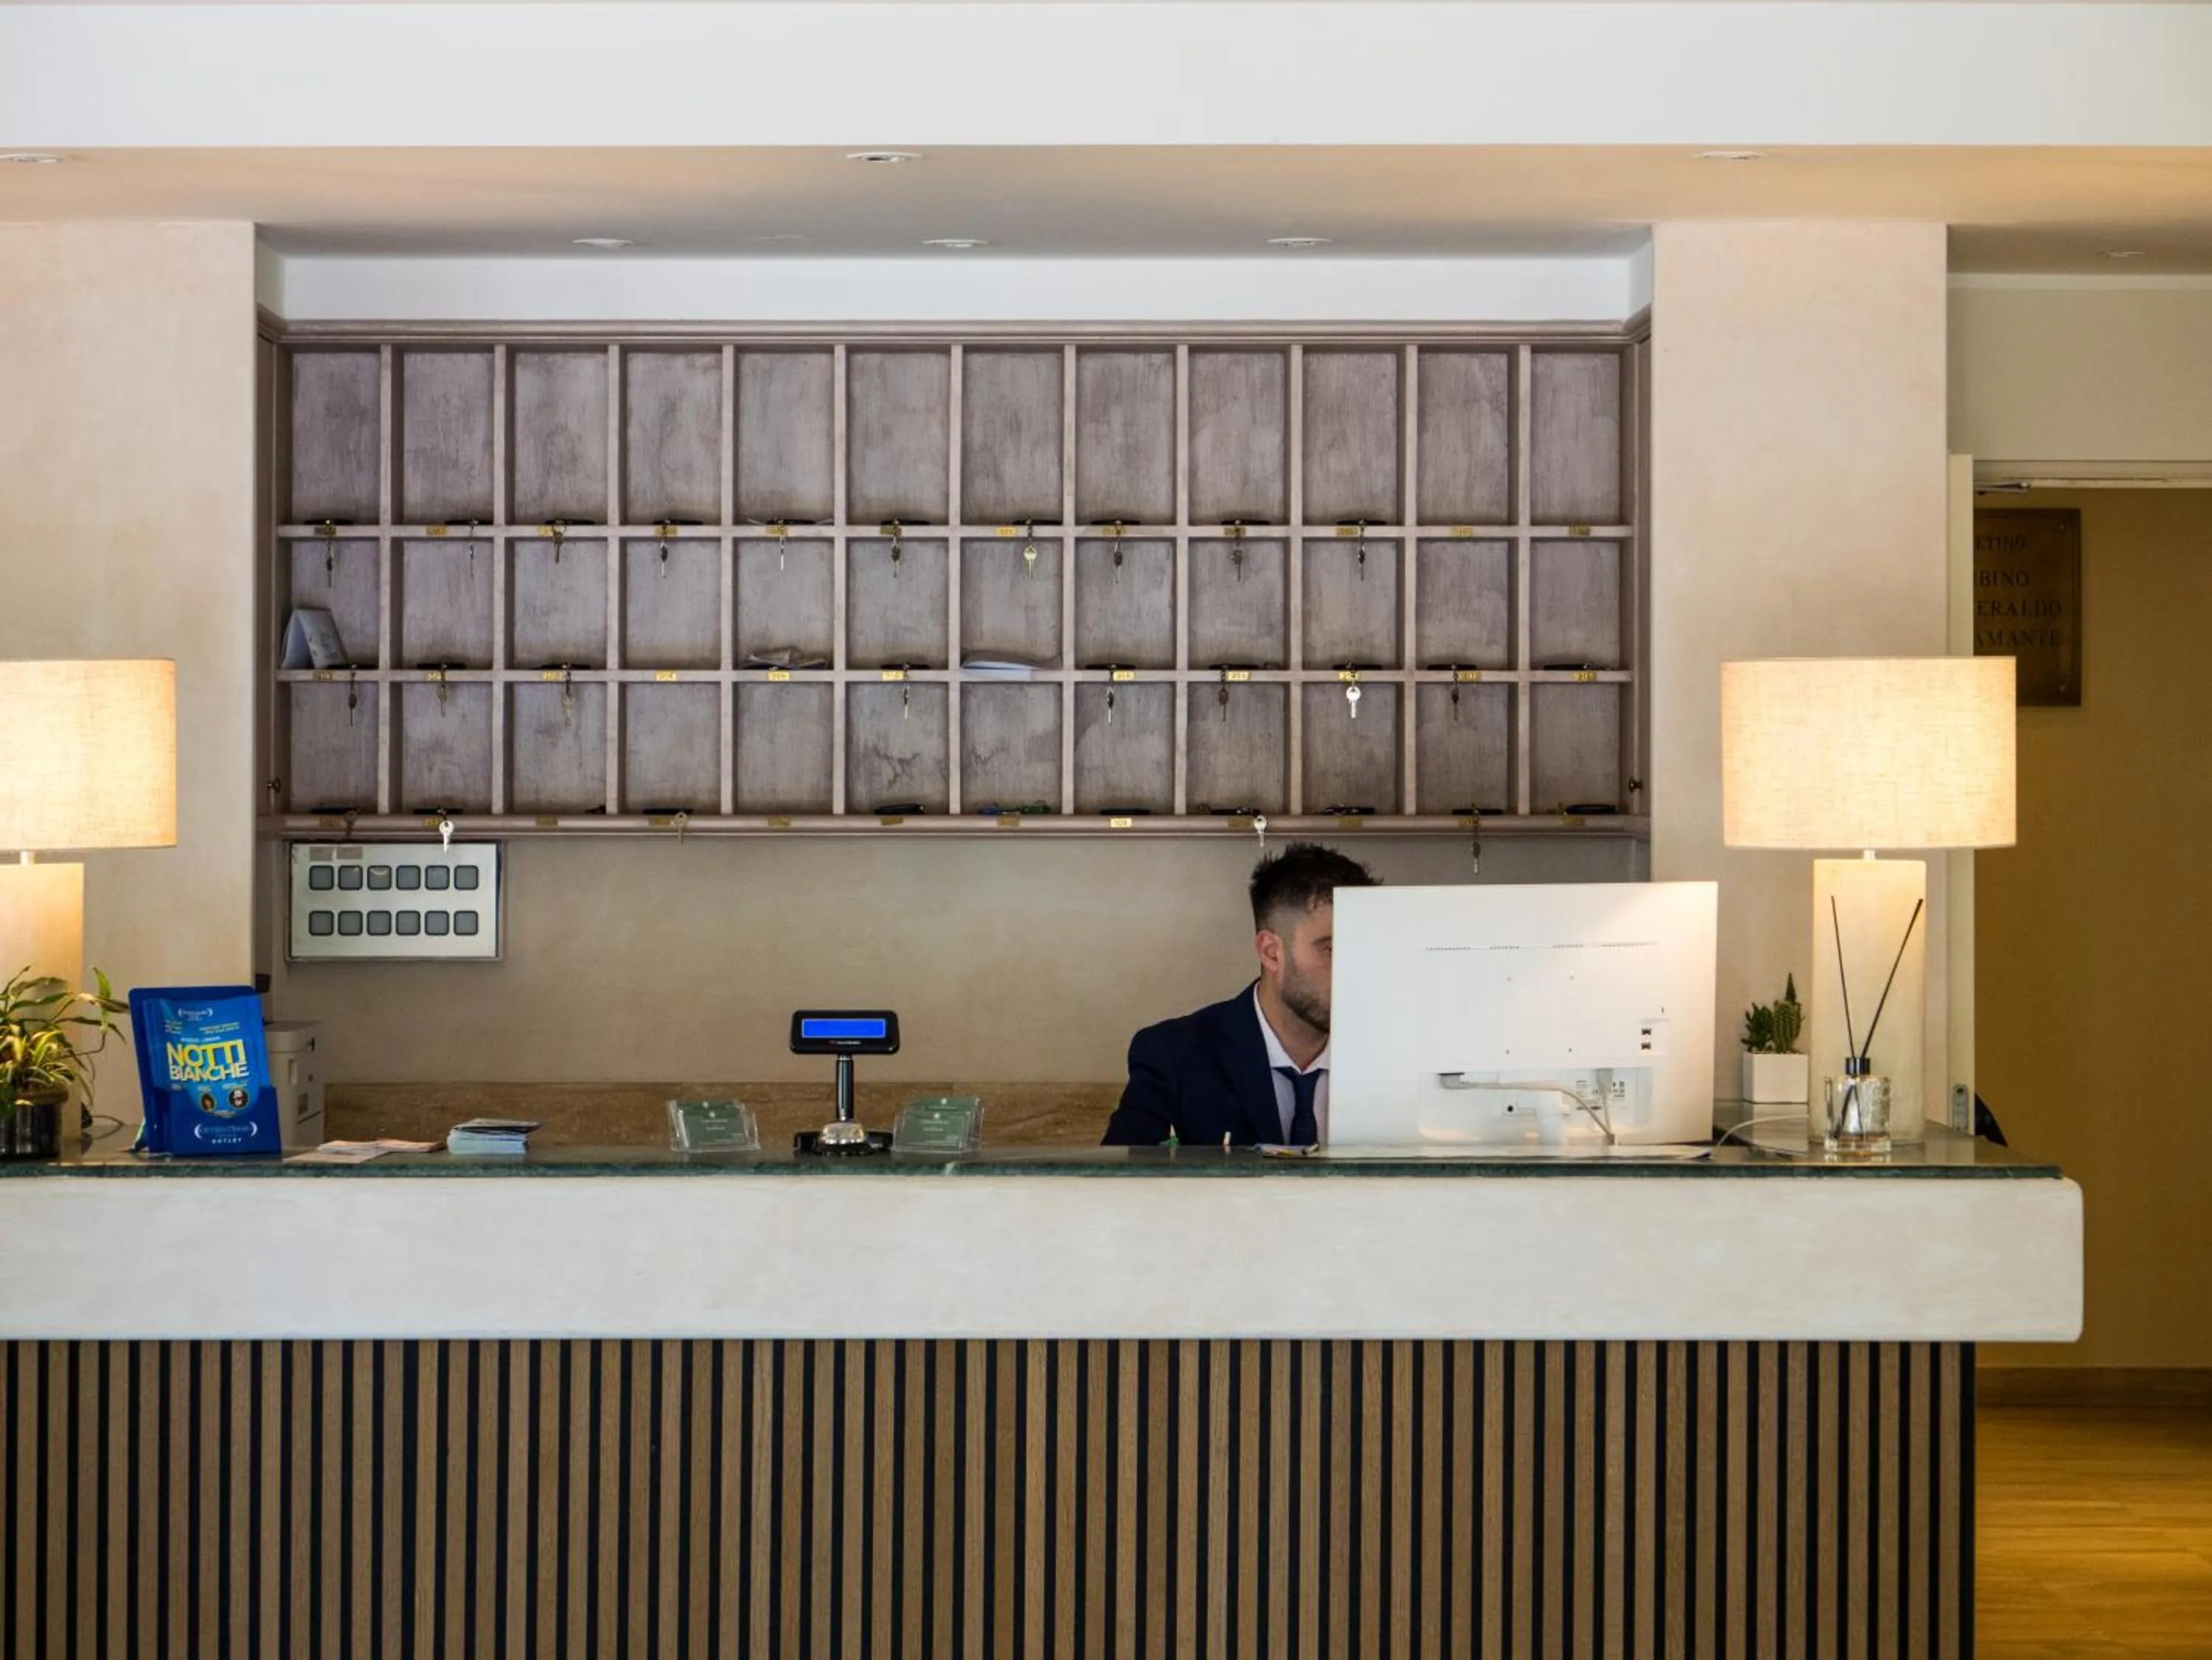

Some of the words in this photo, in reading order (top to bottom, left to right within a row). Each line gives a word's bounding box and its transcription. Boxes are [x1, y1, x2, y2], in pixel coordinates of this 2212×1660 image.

[1979, 571, 2029, 587] BINO
[1975, 600, 2063, 618] ERALDO
[167, 1039, 246, 1067] NOTTI
[170, 1061, 249, 1081] BIANCHE
